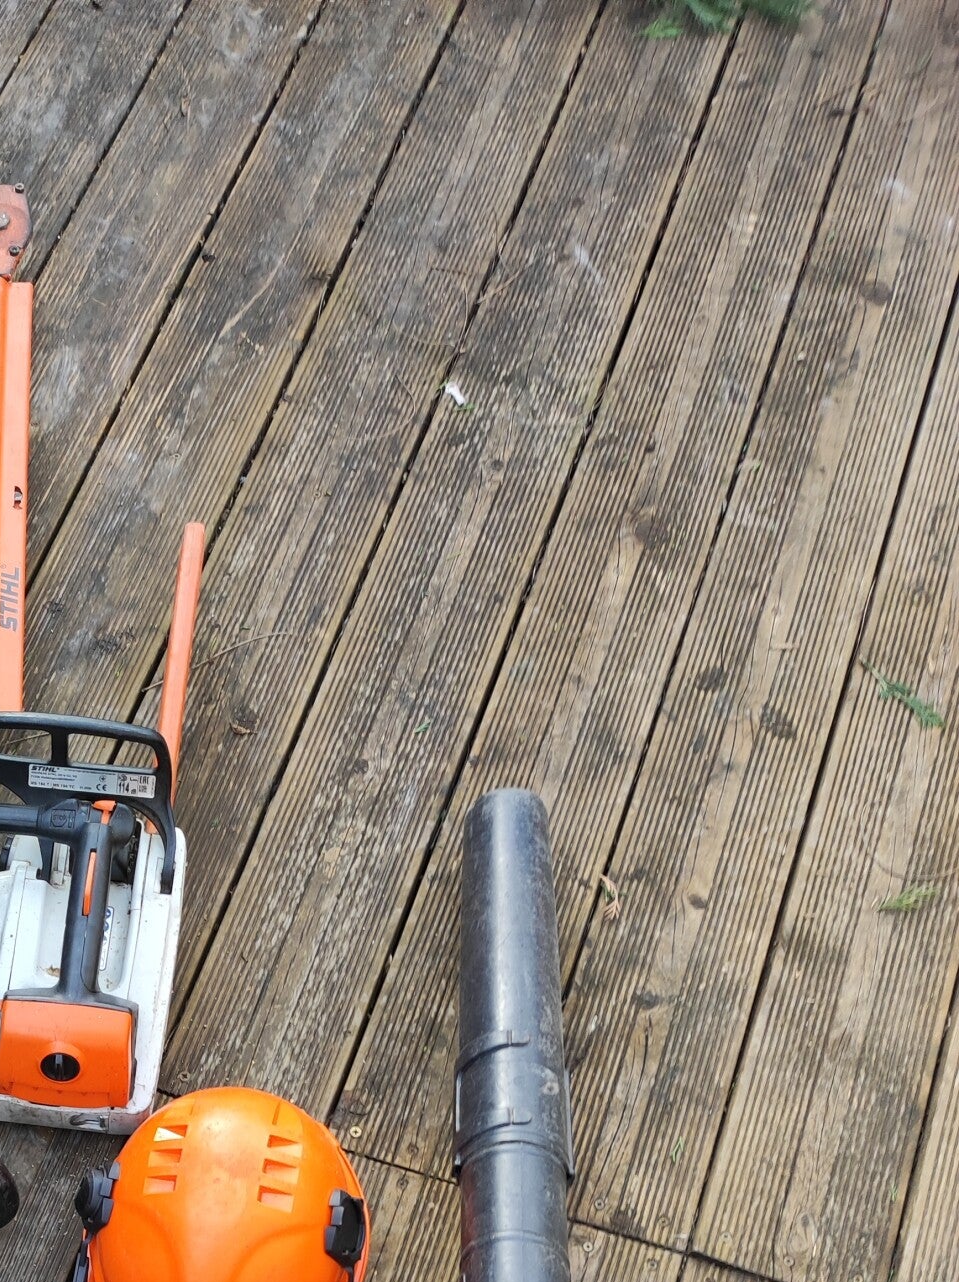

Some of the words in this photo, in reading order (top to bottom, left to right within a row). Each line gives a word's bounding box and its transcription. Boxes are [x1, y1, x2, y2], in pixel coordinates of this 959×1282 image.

[0, 567, 19, 632] STIHL
[31, 765, 57, 773] STIHL
[118, 781, 130, 794] 114
